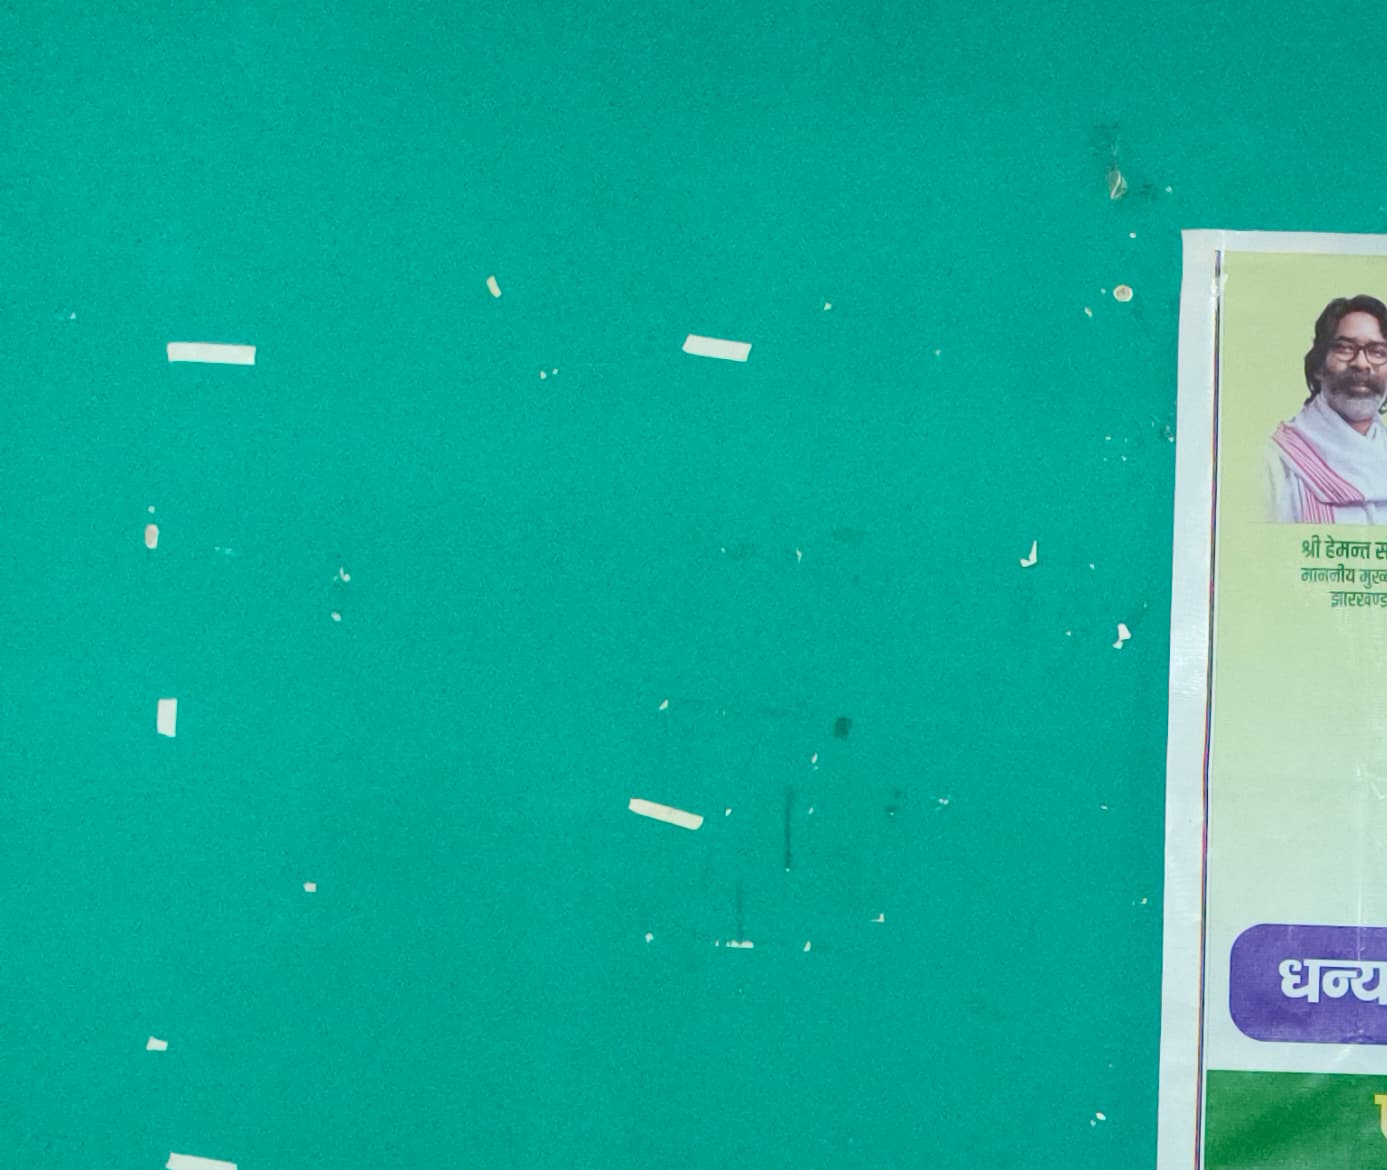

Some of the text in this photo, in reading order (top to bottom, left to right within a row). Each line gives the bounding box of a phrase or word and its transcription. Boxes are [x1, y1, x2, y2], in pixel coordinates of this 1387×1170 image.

[1302, 535, 1320, 559] श्री
[1324, 535, 1372, 559] हेमन्त
[1300, 563, 1355, 583] माननीय
